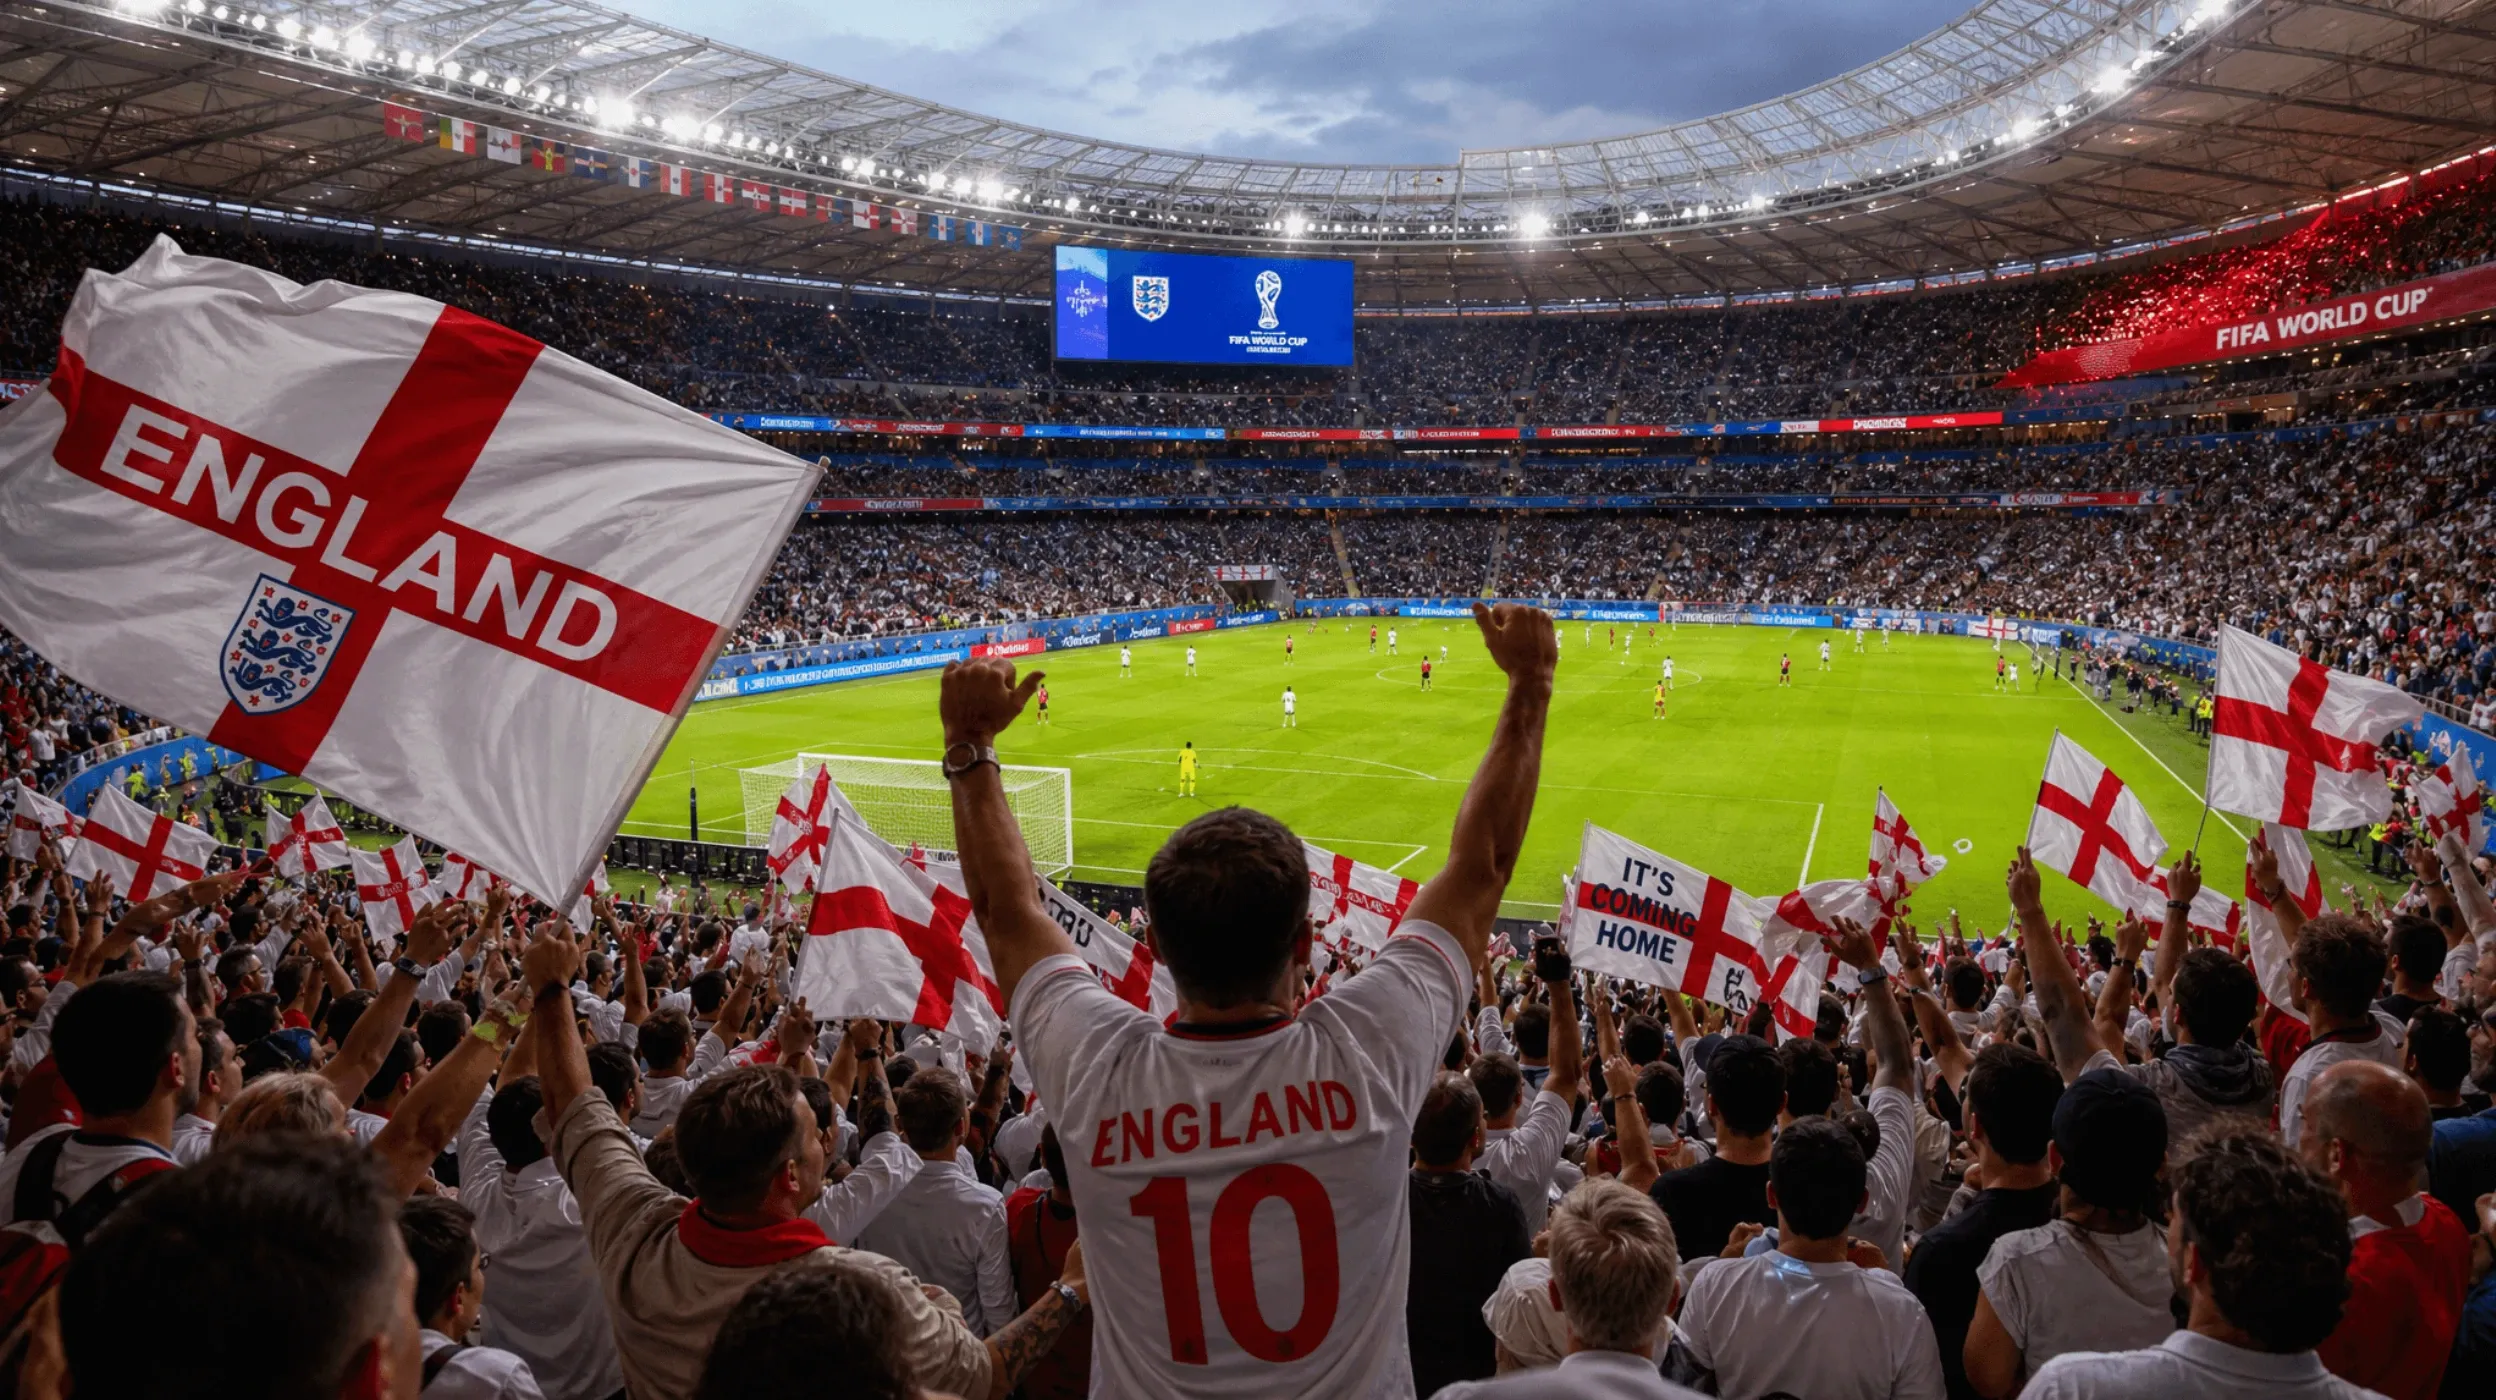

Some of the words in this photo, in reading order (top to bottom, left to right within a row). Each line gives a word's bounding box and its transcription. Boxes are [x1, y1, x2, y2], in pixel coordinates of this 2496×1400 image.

[1229, 335, 1250, 345] FIFA
[1251, 336, 1286, 346] WORLD
[1288, 337, 1307, 346] CUP
[2216, 321, 2270, 350] FIFA
[2277, 302, 2367, 339] WORLD
[2375, 288, 2427, 319] CUP
[100, 404, 618, 661] ENGLAND
[1622, 857, 1675, 897] IT'S
[1590, 883, 1697, 938] COMING
[1596, 919, 1678, 965] HOME
[1091, 1080, 1357, 1168] ENGLAND
[1129, 1163, 1340, 1366] 10
